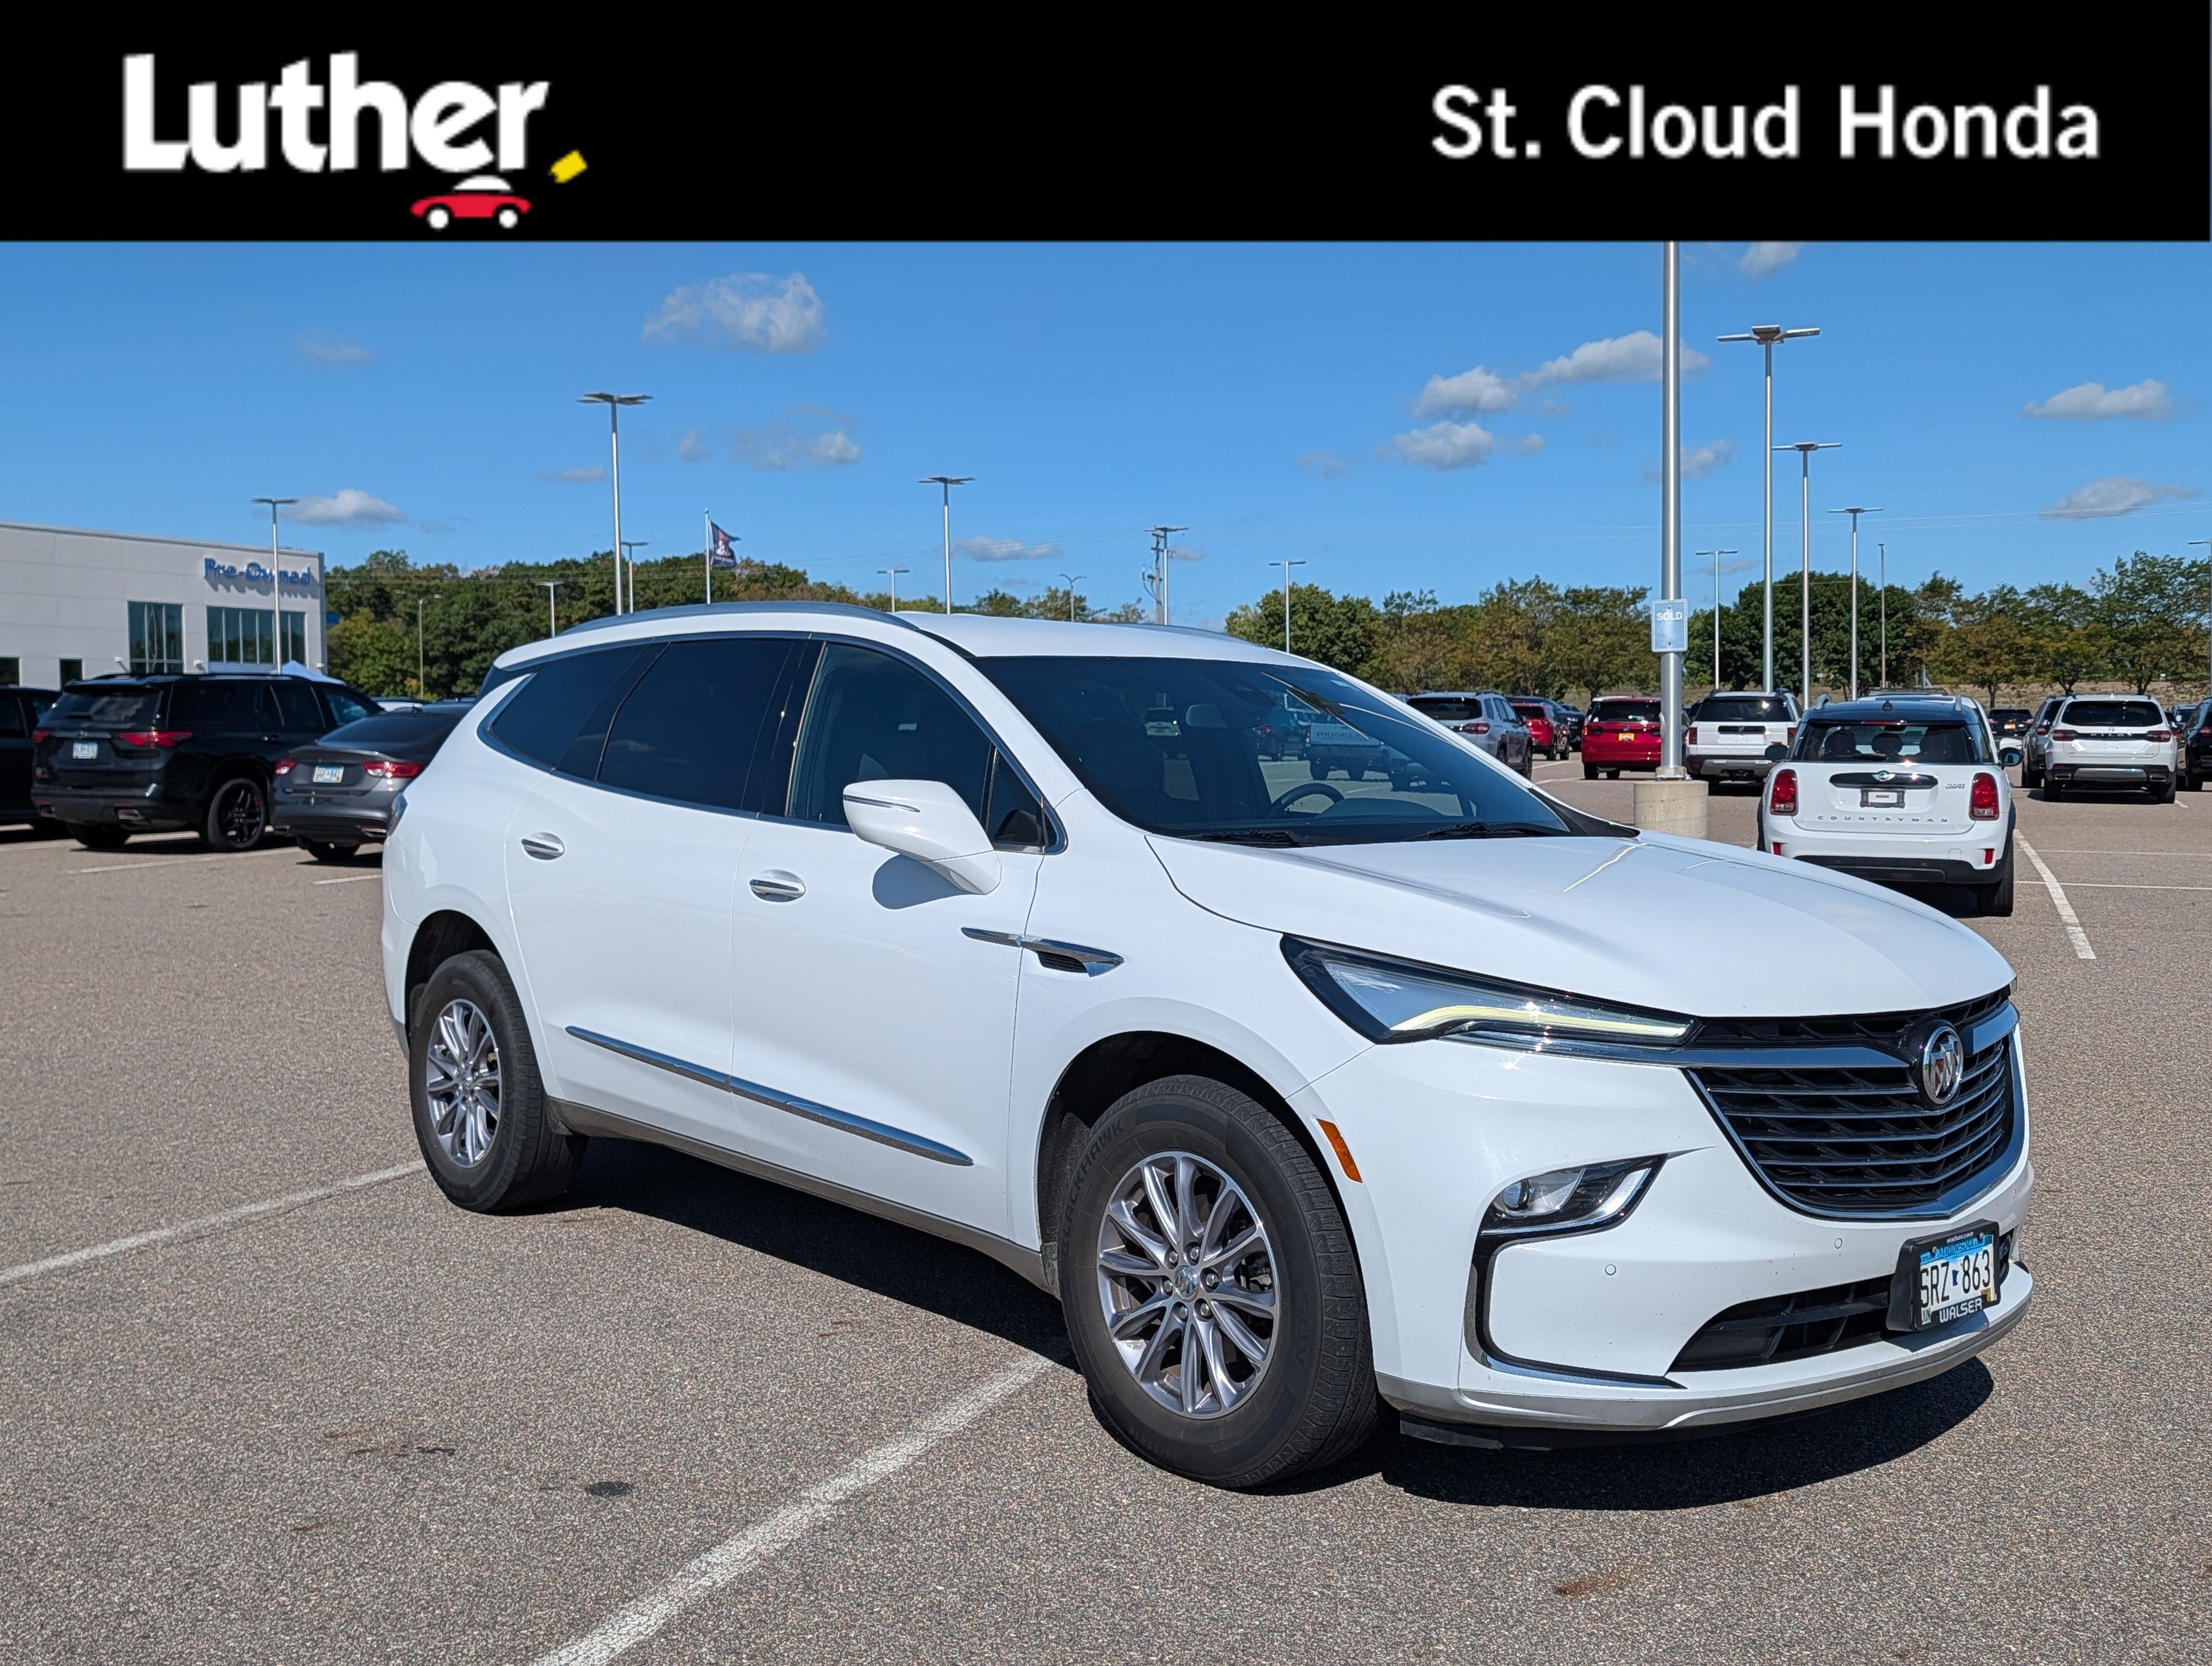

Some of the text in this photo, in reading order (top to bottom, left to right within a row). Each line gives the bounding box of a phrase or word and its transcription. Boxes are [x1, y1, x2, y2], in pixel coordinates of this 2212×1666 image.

[204, 556, 311, 585] Pre-Owned
[1657, 611, 1683, 621] SOLD
[1817, 815, 1948, 823] COUNTRYMAN
[1060, 1118, 1124, 1258] BLACKHAWK
[1947, 1232, 1973, 1244] walser.com
[1920, 1249, 1990, 1308] SRZ 863
[1939, 1298, 1983, 1323] WALSER
